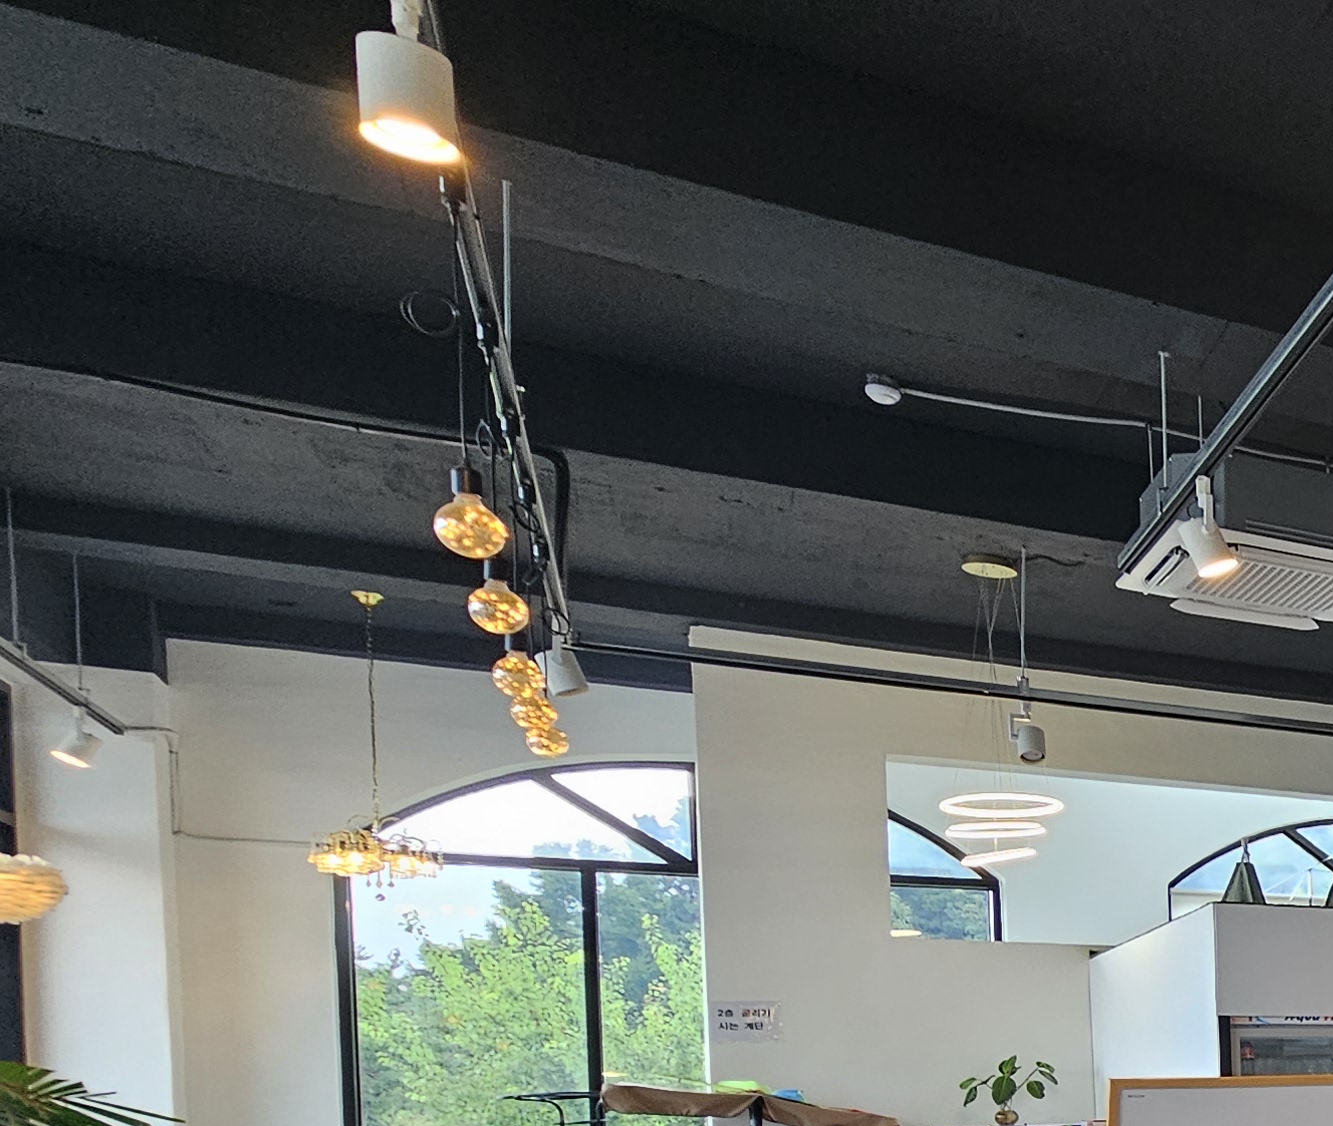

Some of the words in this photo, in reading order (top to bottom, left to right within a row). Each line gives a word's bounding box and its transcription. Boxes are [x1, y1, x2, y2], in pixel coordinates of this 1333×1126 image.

[717, 1008, 734, 1018] 2층
[718, 1021, 739, 1031] 시는
[744, 1021, 764, 1031] 계단
